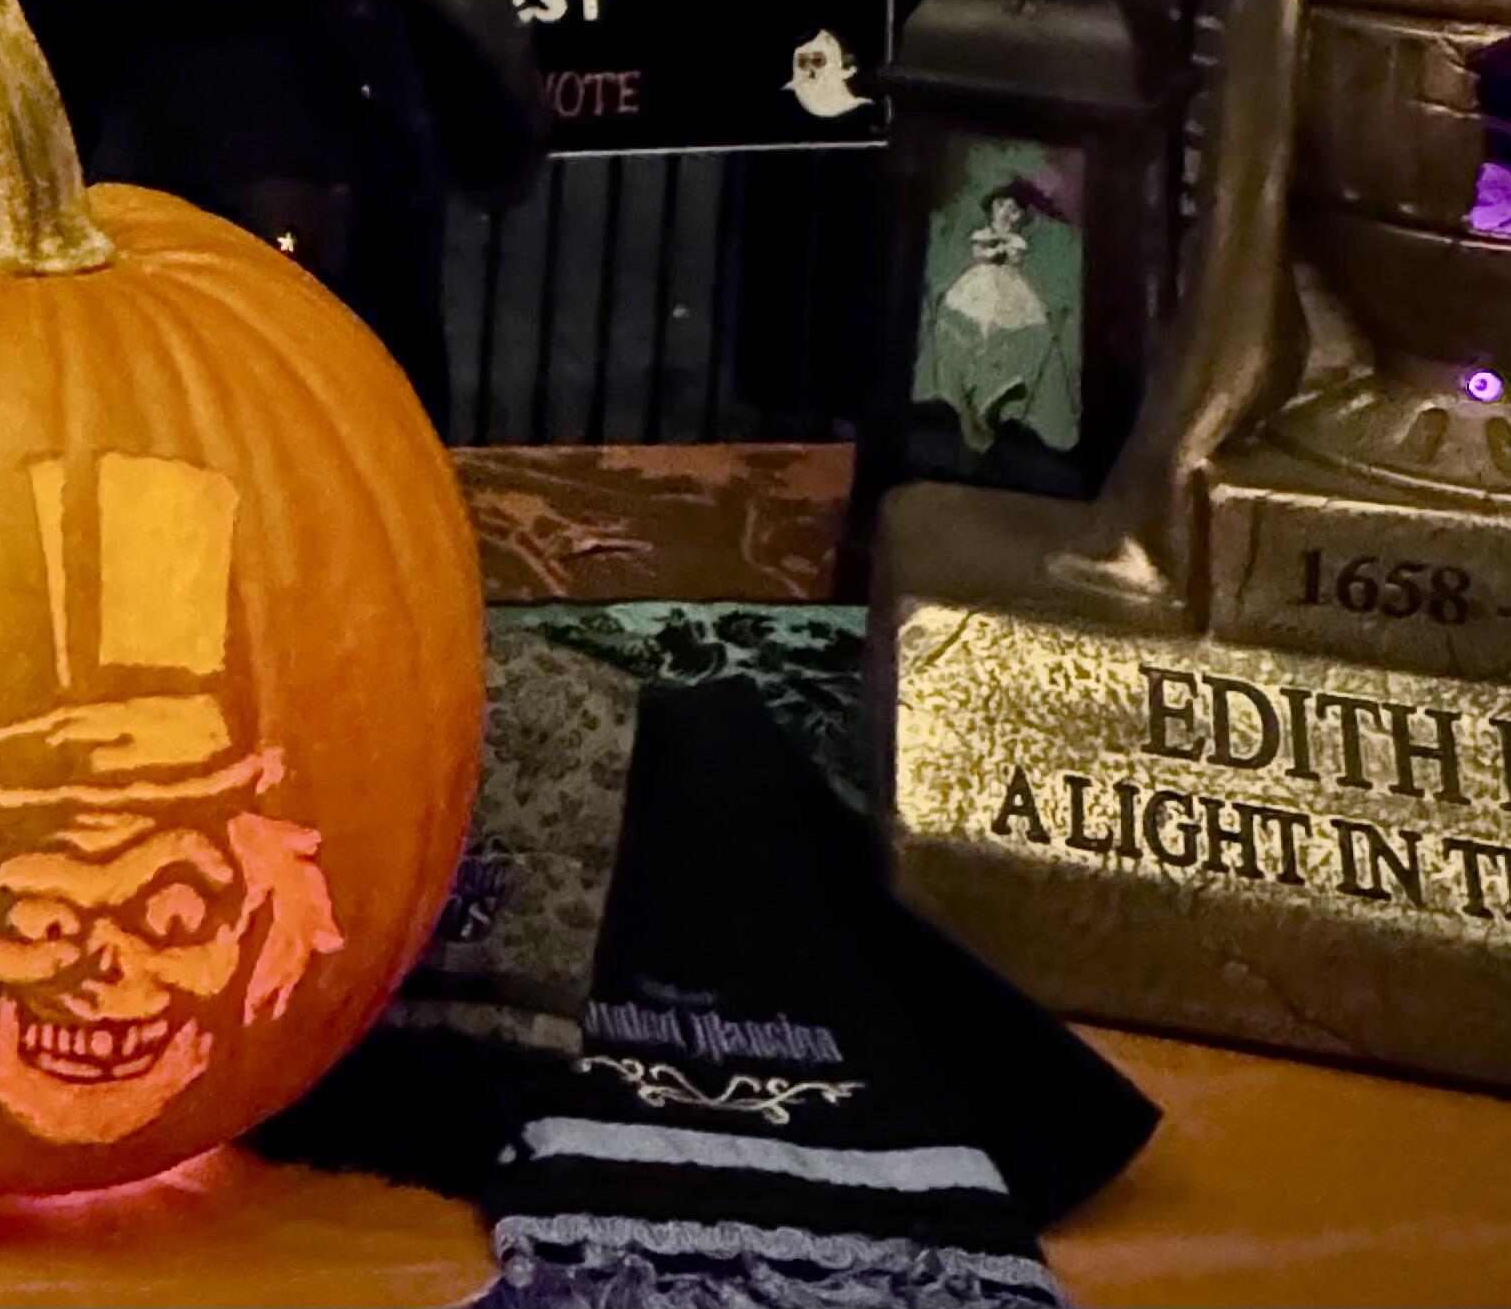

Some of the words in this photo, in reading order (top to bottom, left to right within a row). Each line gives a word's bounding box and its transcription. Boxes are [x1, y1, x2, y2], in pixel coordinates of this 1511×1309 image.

[1291, 549, 1472, 626] 1658
[1139, 663, 1473, 806] EDITH
[990, 764, 1052, 845] A
[1063, 774, 1312, 886] LIGHT
[1330, 817, 1424, 910] IN
